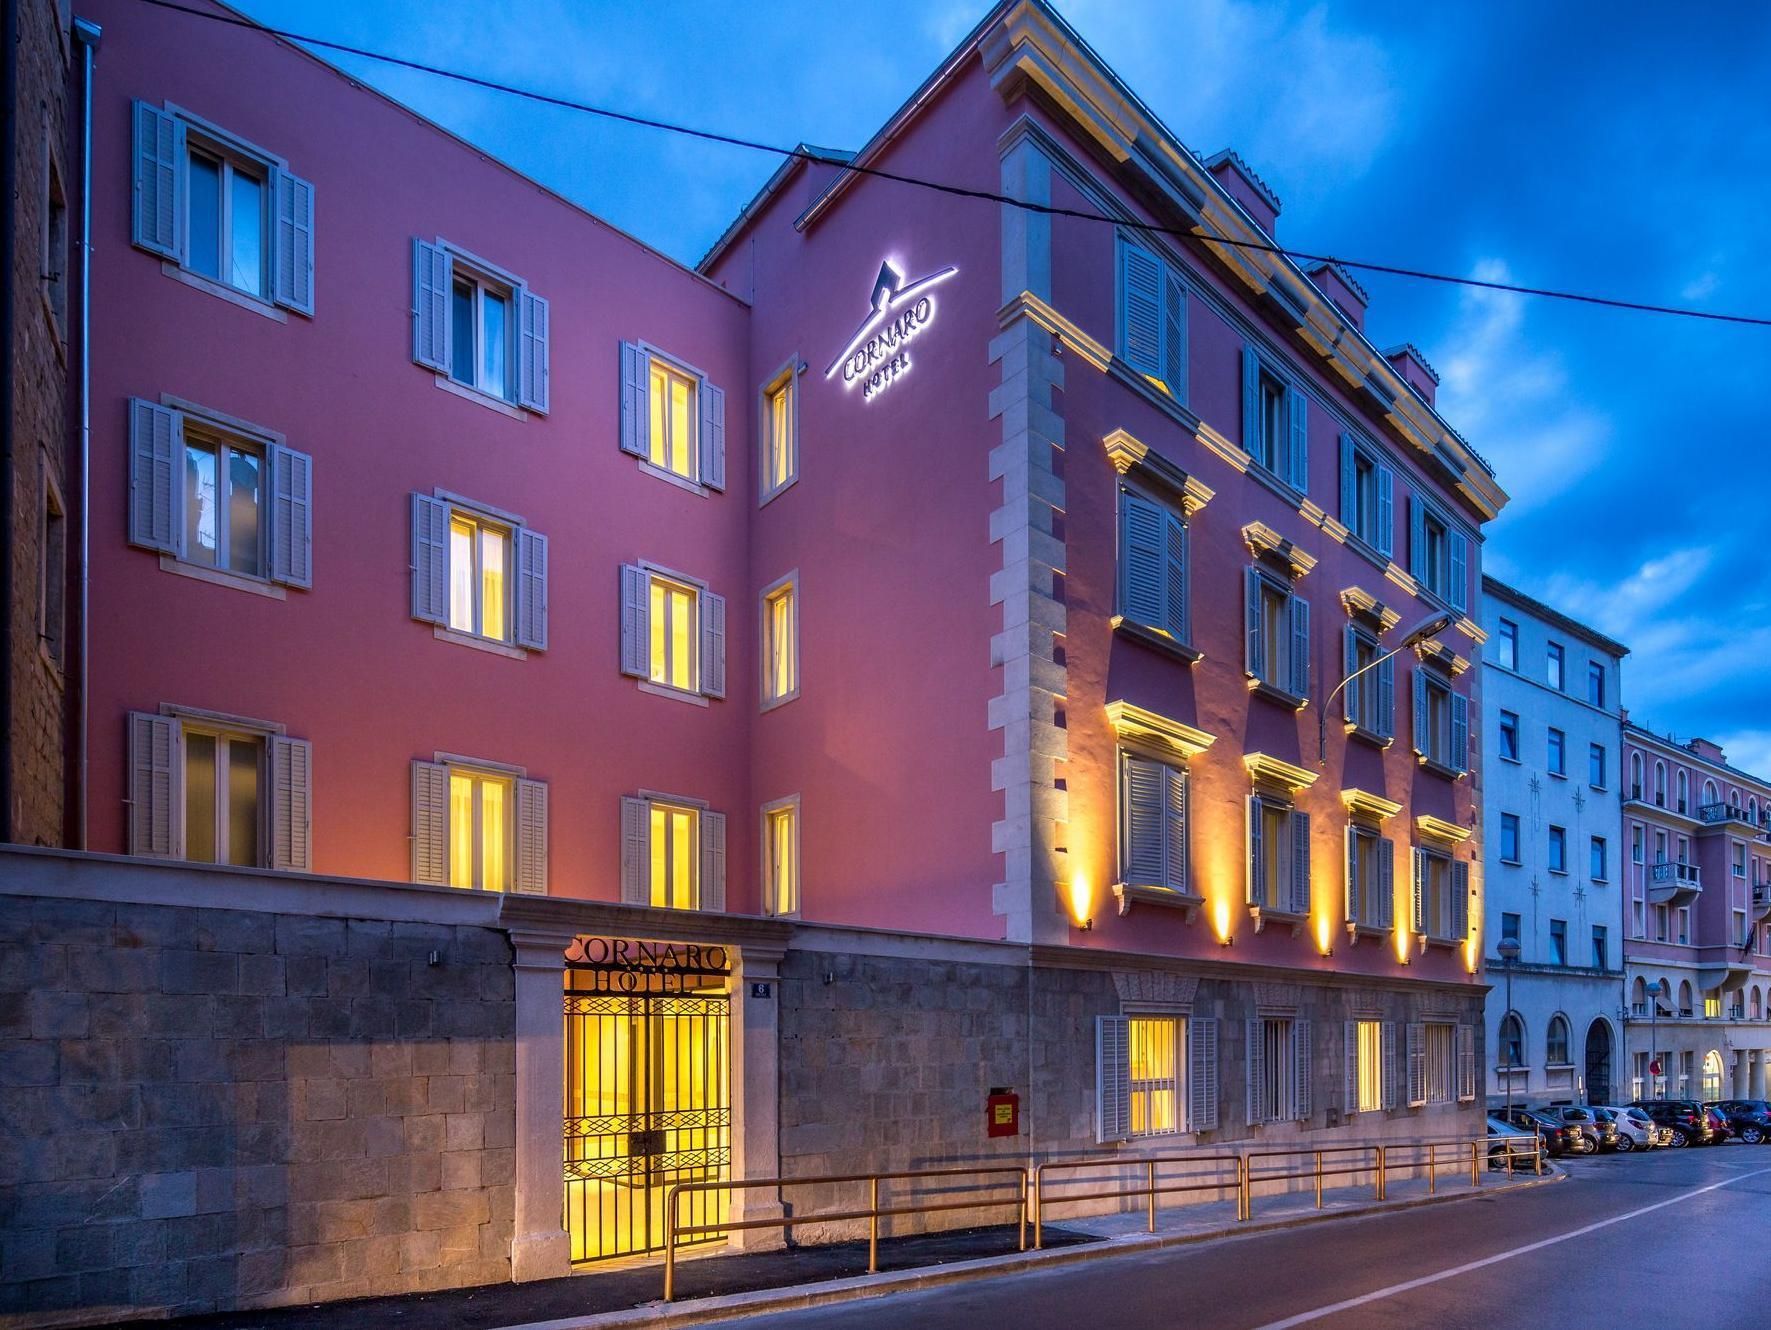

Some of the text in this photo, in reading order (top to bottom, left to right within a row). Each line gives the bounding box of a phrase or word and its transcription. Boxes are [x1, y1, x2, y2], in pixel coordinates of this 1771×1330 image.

[843, 297, 932, 382] CORNARO
[863, 353, 910, 397] HOTEL
[564, 937, 728, 970] CORNARO
[594, 970, 692, 994] HOTEL
